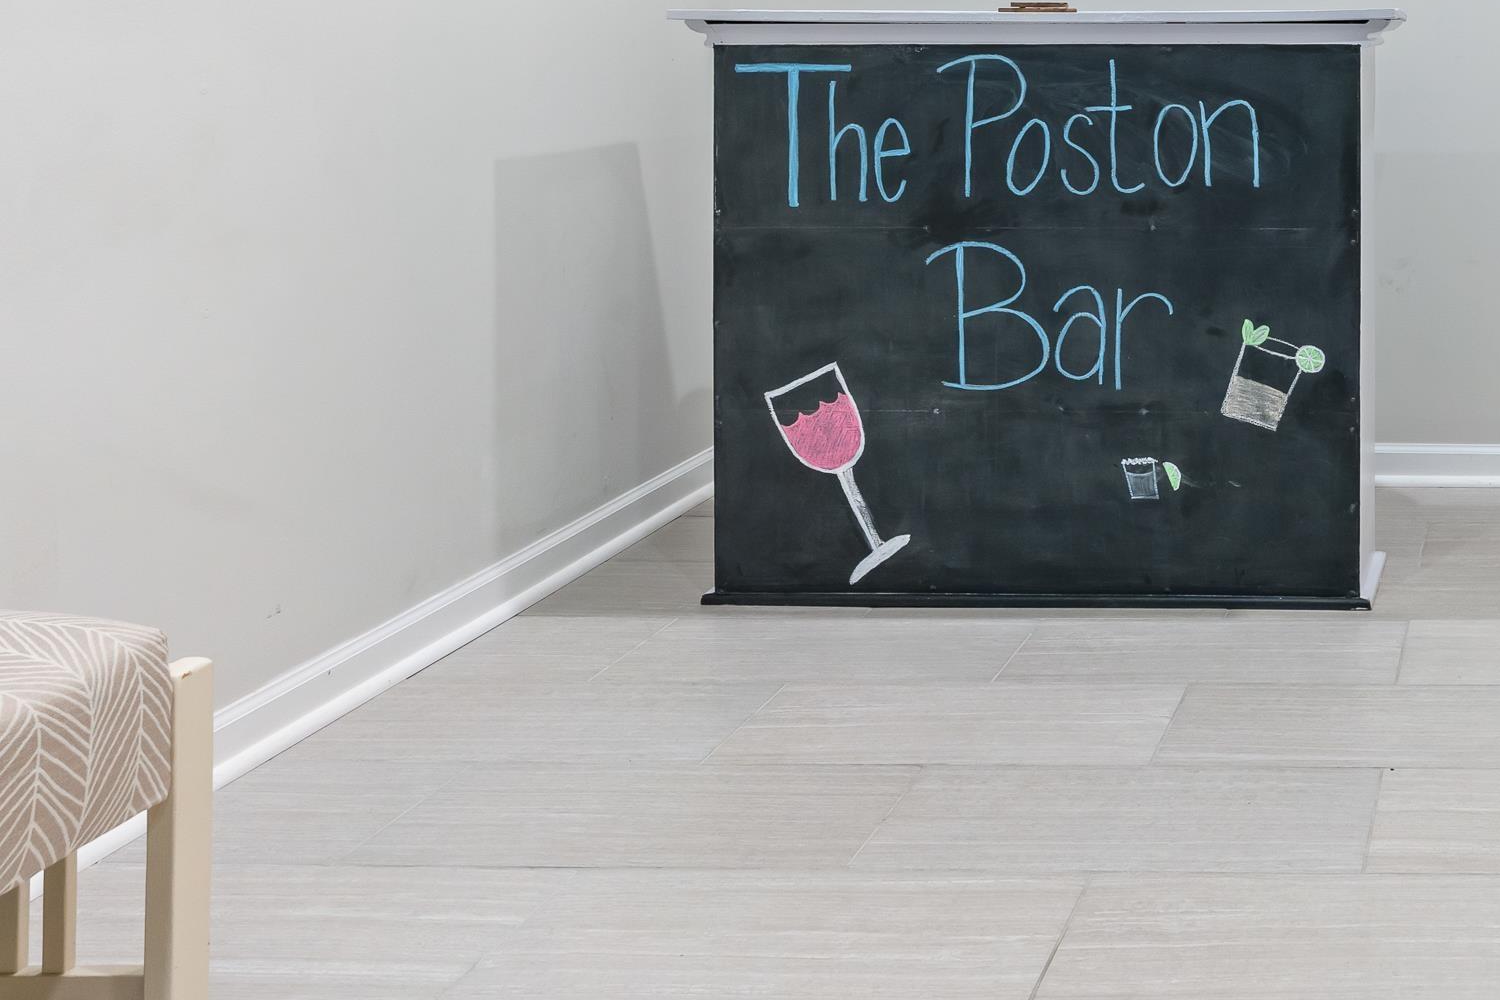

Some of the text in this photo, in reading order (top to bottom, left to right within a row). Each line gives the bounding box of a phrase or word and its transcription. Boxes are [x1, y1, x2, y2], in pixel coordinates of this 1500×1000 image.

[735, 53, 1261, 208] The Poston
[925, 240, 1174, 391] Bar
